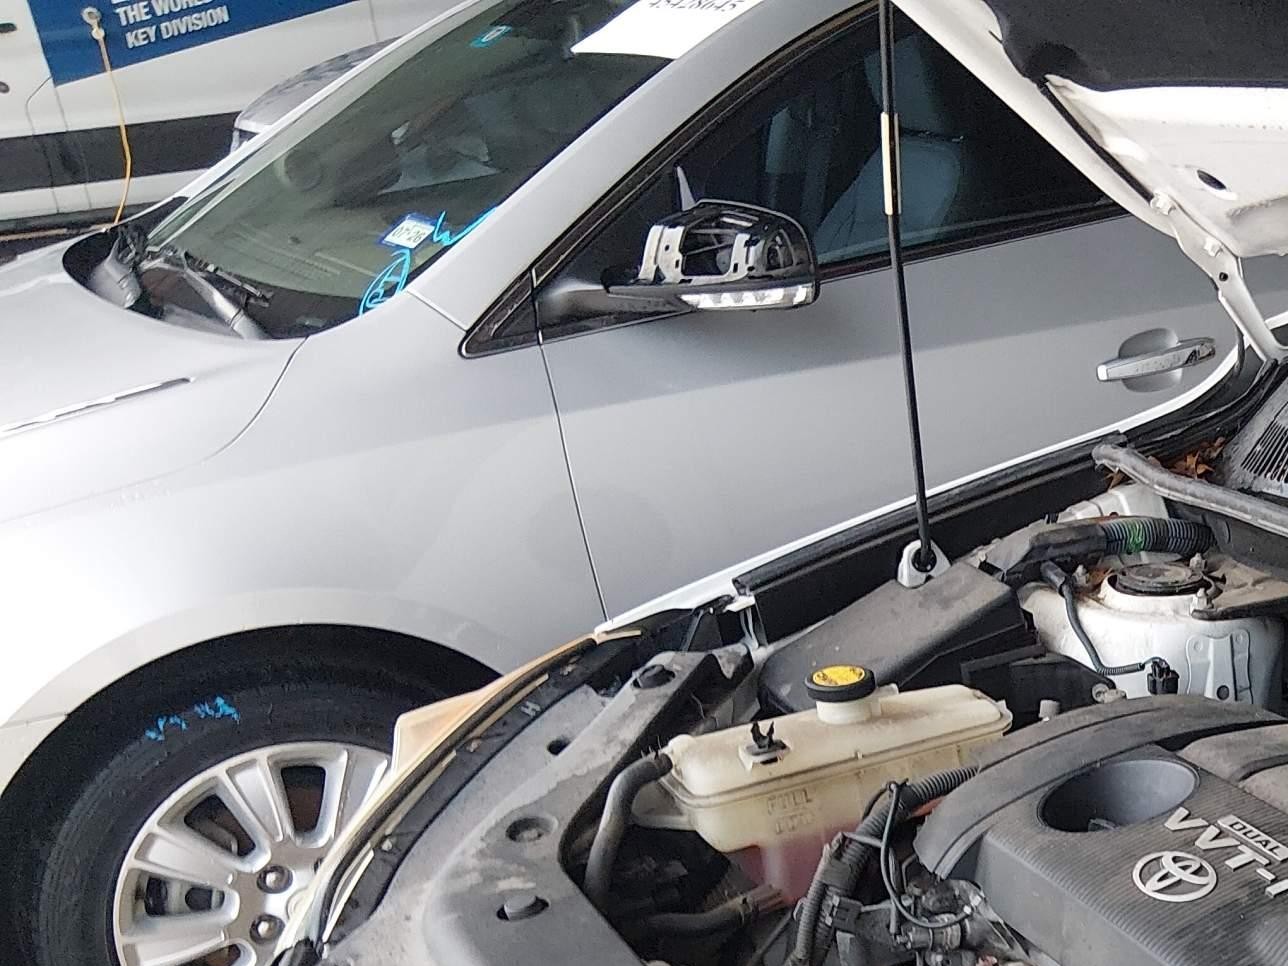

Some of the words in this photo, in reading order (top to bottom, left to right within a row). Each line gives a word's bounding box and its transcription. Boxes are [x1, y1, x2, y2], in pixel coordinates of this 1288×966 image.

[113, 2, 153, 26] THE
[150, 0, 214, 16] WOR
[125, 25, 157, 49] KEY
[159, 5, 230, 39] DIVISION
[1228, 820, 1284, 858] DUAL
